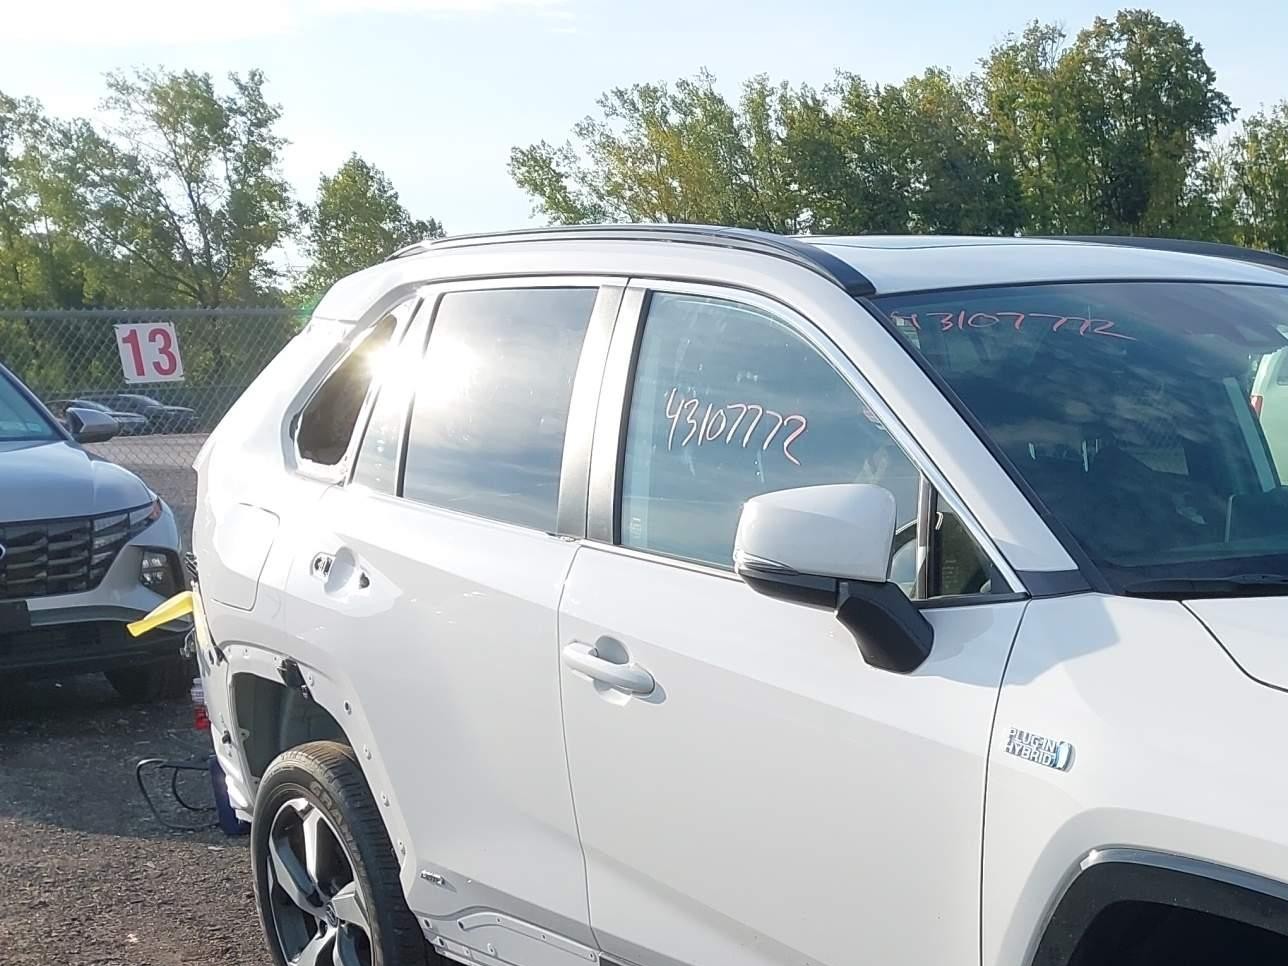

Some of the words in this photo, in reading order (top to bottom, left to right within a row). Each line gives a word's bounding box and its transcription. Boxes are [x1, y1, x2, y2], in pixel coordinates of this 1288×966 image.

[122, 327, 177, 377] 13
[665, 387, 808, 466] 43107772
[1003, 741, 1053, 766] HYBRID
[1007, 728, 1058, 753] PLUG-IN
